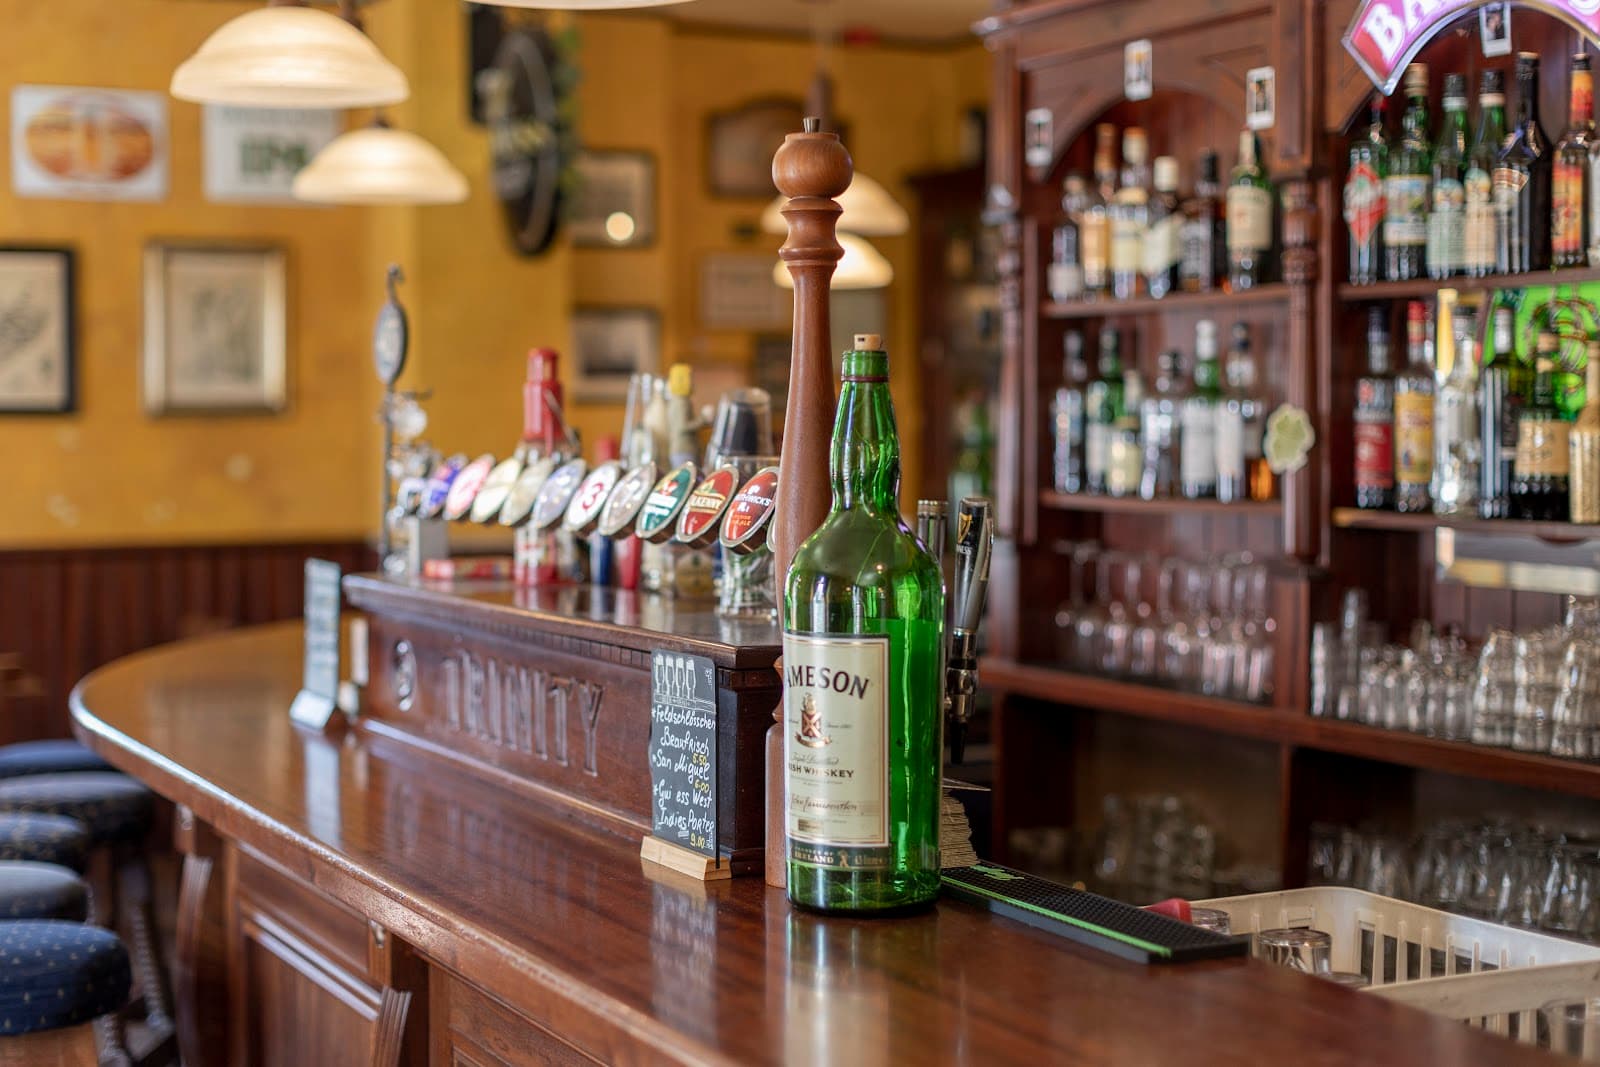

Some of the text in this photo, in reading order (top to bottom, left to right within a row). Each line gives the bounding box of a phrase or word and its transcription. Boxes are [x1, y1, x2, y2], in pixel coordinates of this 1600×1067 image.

[787, 664, 869, 700] AMESON
[656, 748, 711, 784] San Miguel
[788, 762, 855, 779] ISH WHSKEY
[692, 789, 713, 809] West
[658, 807, 688, 831] Indies
